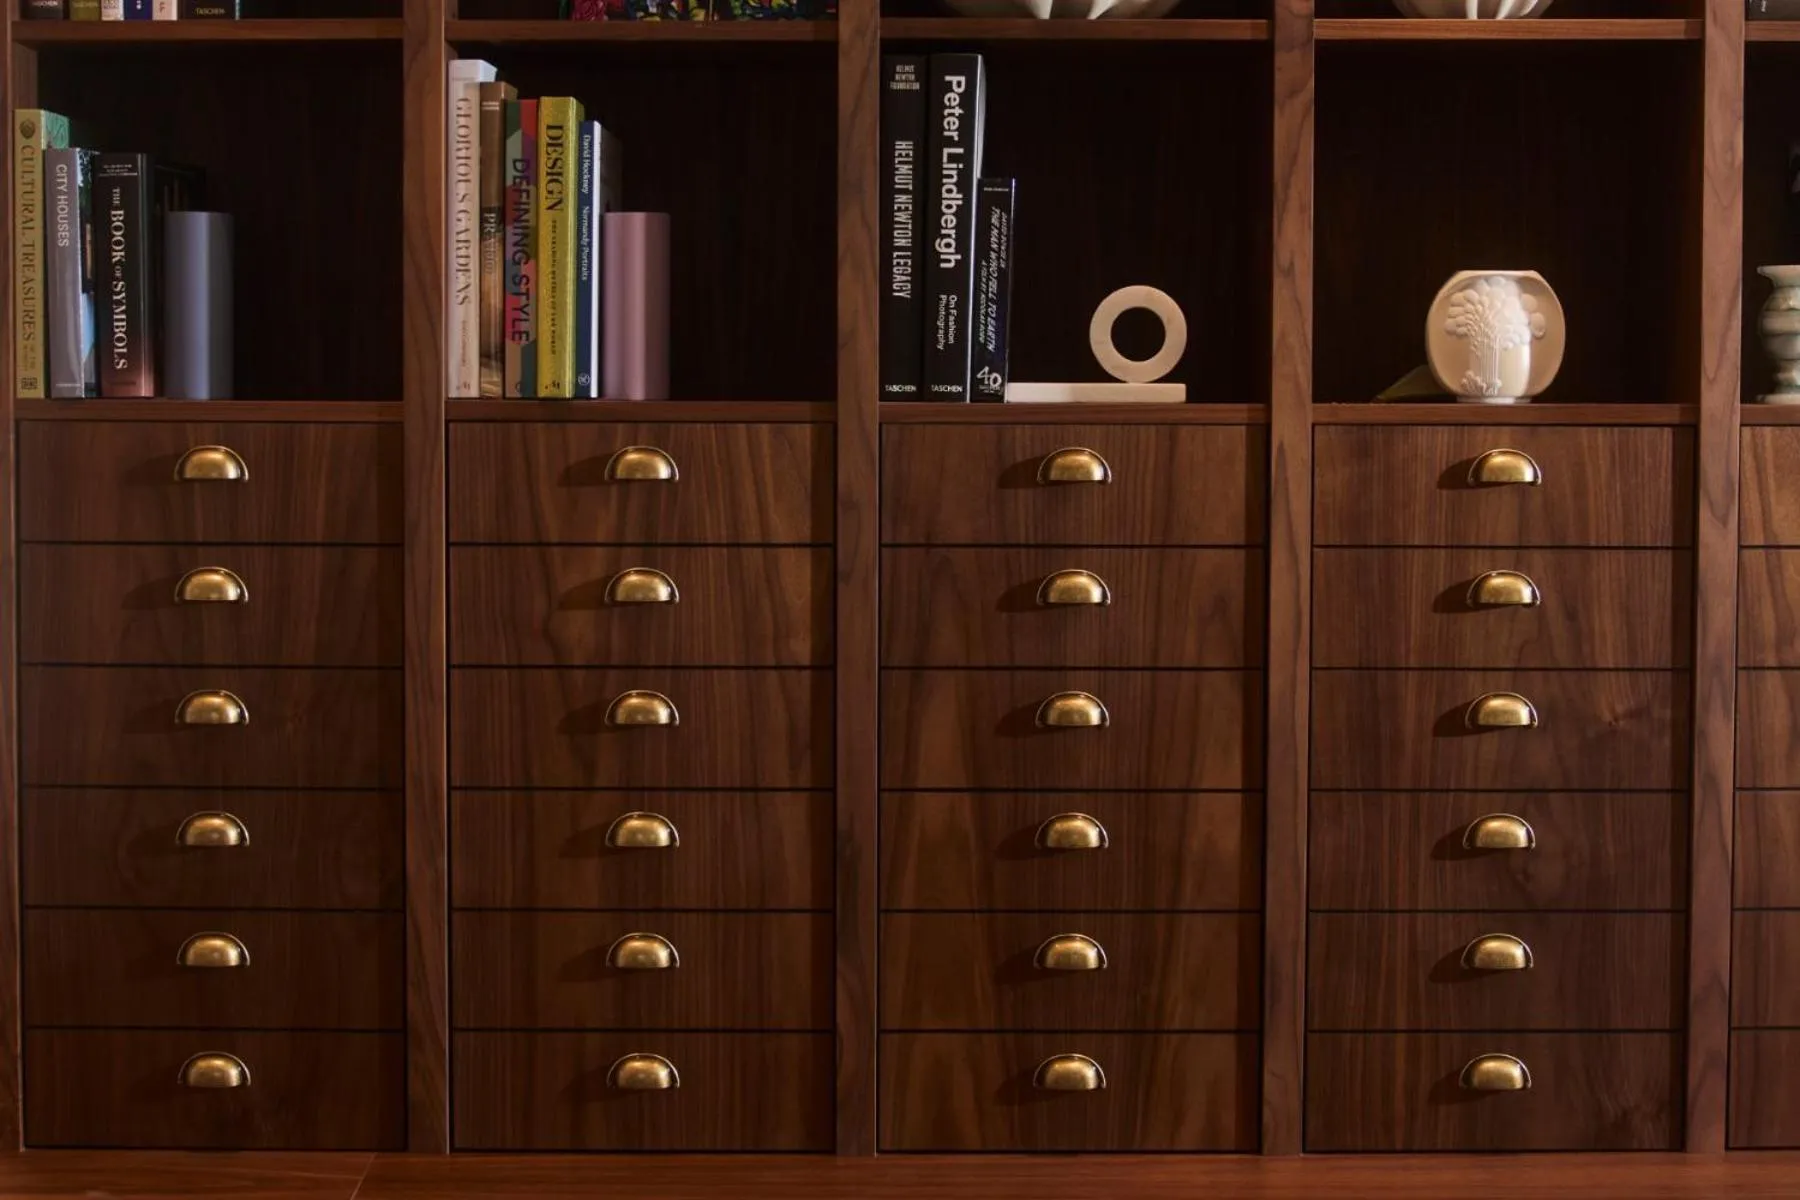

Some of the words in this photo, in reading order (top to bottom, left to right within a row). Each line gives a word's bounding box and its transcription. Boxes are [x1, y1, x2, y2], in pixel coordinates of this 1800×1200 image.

[943, 75, 966, 141] Peter
[456, 98, 471, 203] GLORIOUS
[545, 124, 564, 211] DESIGN
[583, 134, 591, 158] David
[894, 141, 914, 190] HELMUT
[21, 145, 35, 236] CULTURAL
[56, 164, 68, 192] CITY
[112, 187, 121, 205] THE
[581, 159, 591, 194] Hockney
[57, 195, 70, 247] HOUSES
[512, 159, 530, 266] DEFINING
[580, 206, 591, 245] Normandy
[893, 194, 913, 247] NEWTON
[934, 147, 964, 269] Lindbergh
[991, 206, 1001, 227] THE
[110, 210, 126, 262] BOOK
[456, 210, 471, 306] GARDENS
[990, 226, 1000, 251] MAN
[892, 251, 912, 299] LEGACY
[989, 250, 998, 277] WHO
[22, 240, 36, 341] TREASURES
[511, 274, 530, 342] STYLE
[948, 295, 958, 308] On
[987, 302, 997, 317] TO
[112, 281, 128, 370] SYMBOLS
[936, 295, 948, 350] Photography
[948, 310, 958, 344] Fashion
[986, 317, 996, 352] EARTH
[931, 384, 963, 393] TASCHEN
[977, 365, 1002, 388] 40
